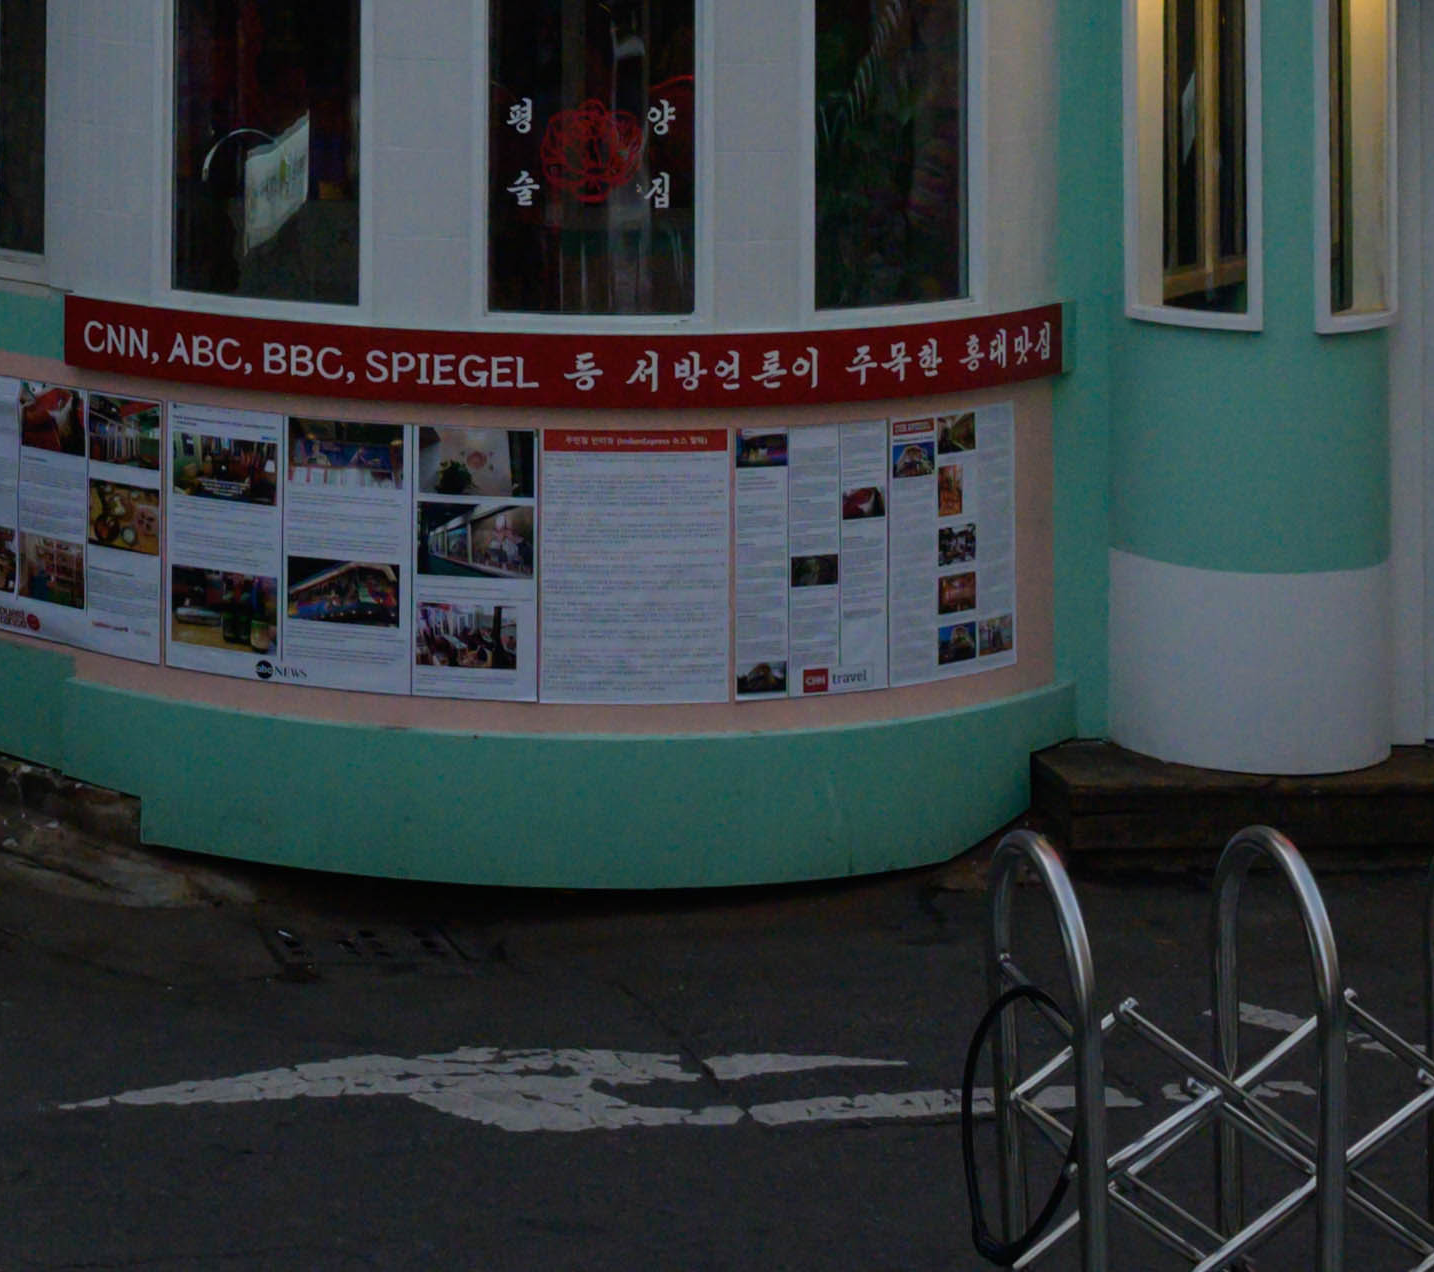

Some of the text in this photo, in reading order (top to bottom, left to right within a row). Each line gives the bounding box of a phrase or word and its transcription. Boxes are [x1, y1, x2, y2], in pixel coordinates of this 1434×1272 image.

[83, 319, 540, 390] CNN, ABC, BBC, SPIEGEL
[563, 351, 604, 392] 등
[845, 336, 944, 386] 주목한
[958, 319, 1053, 374] 홍대맛집
[274, 665, 308, 679] NEWS
[832, 669, 867, 685] travel
